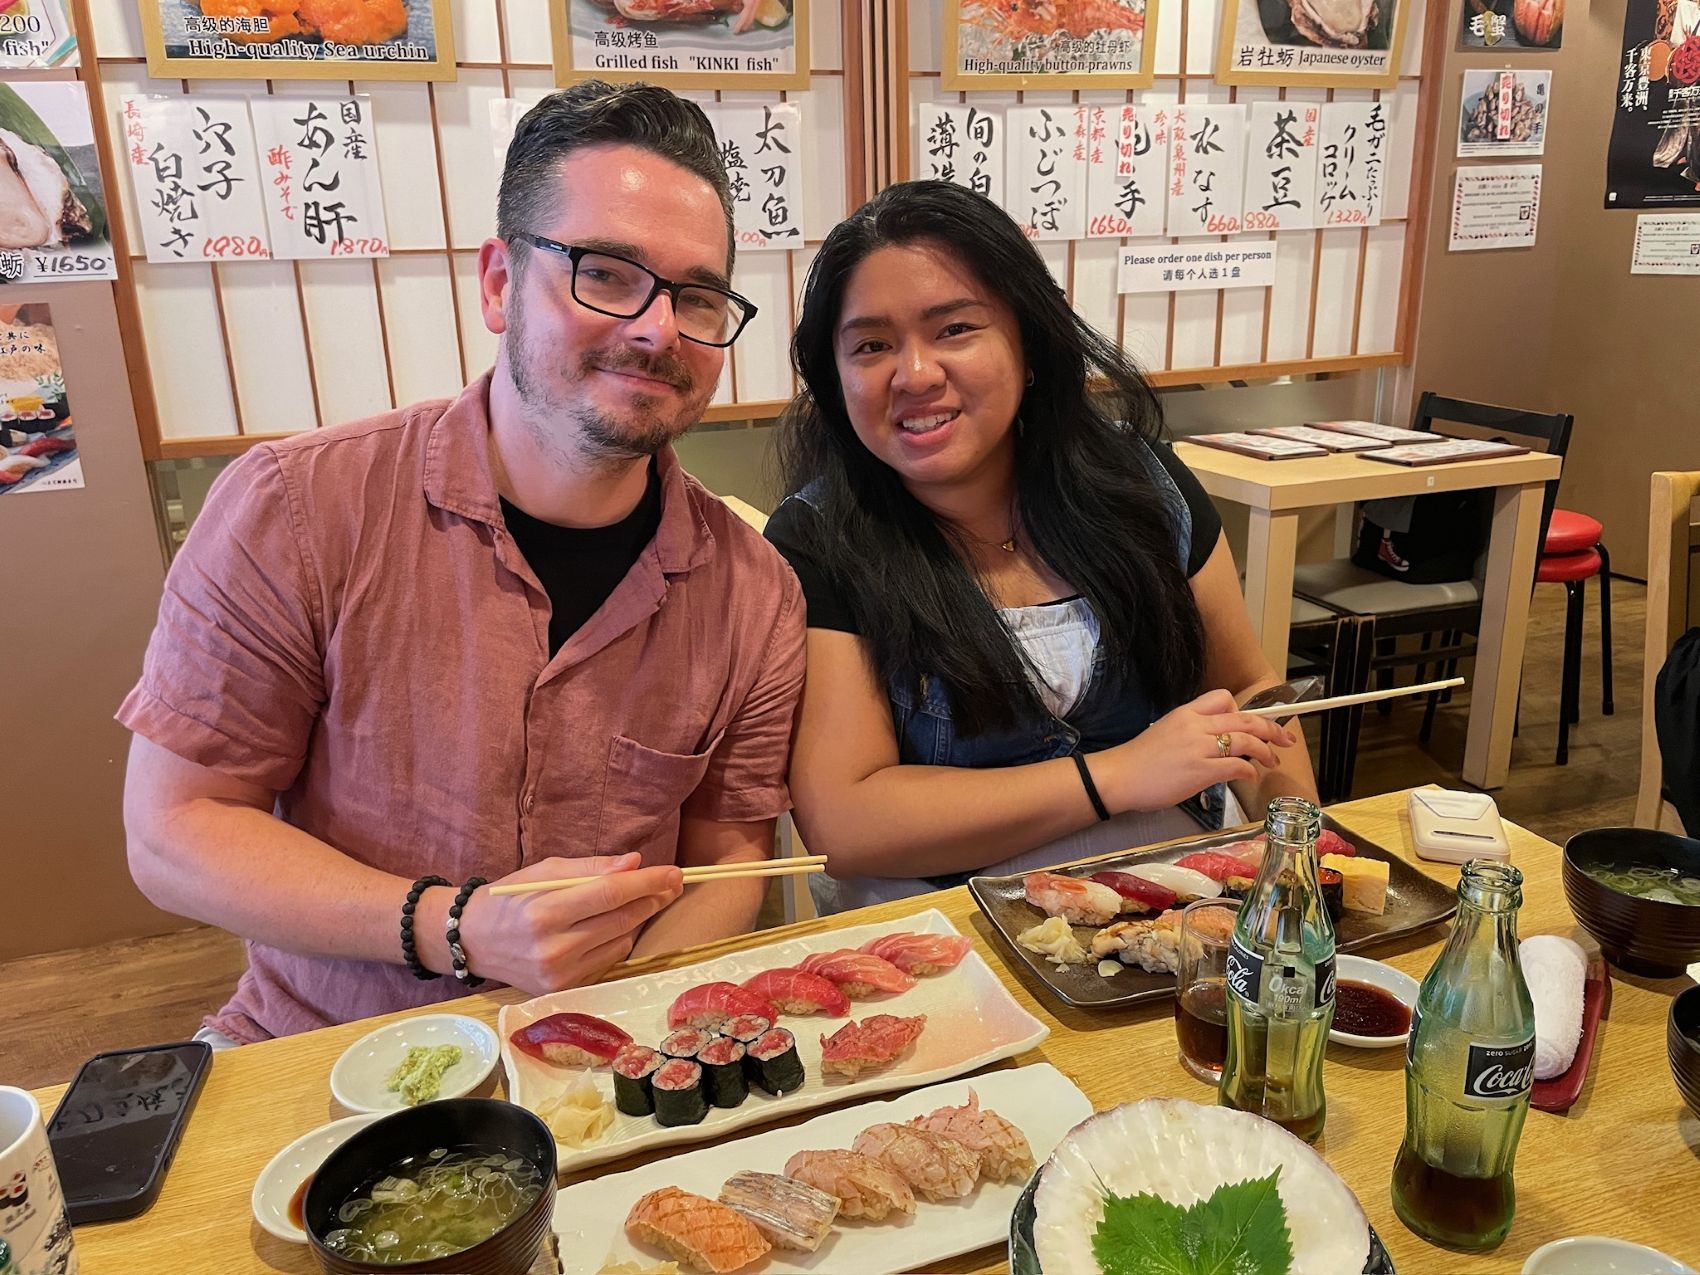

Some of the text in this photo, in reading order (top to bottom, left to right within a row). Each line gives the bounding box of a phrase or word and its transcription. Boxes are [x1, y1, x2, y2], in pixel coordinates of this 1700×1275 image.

[4, 40, 48, 56] fish"
[184, 16, 270, 34] 高级的海胆
[188, 39, 429, 61] High-quality Sea urchin
[594, 31, 659, 49] 高级烤鱼
[1060, 40, 1132, 54] 高级的牡丹虾
[1469, 14, 1507, 37] 毛蟹
[596, 55, 779, 72] Grilled fish "KINKI fish"
[965, 59, 1132, 74] High-quality button prawns
[1299, 51, 1385, 67] Japanese oyster
[193, 107, 244, 200] 穴子
[340, 100, 368, 160] 国産
[1119, 107, 1134, 174] 売り切れ
[1262, 109, 1304, 211] 茶豆
[293, 102, 358, 245] あん肝
[754, 105, 800, 239] 太刀魚
[1030, 109, 1068, 232] ふじつぼ
[1190, 117, 1225, 226] 水なす
[1320, 144, 1338, 213] コロッケ
[1338, 124, 1357, 201] クリーム
[148, 142, 198, 258] 白焼き
[1124, 255, 1155, 265] Please
[1157, 253, 1183, 264] order
[1204, 252, 1223, 262] dish
[1225, 254, 1239, 263] per
[1242, 251, 1272, 262] person
